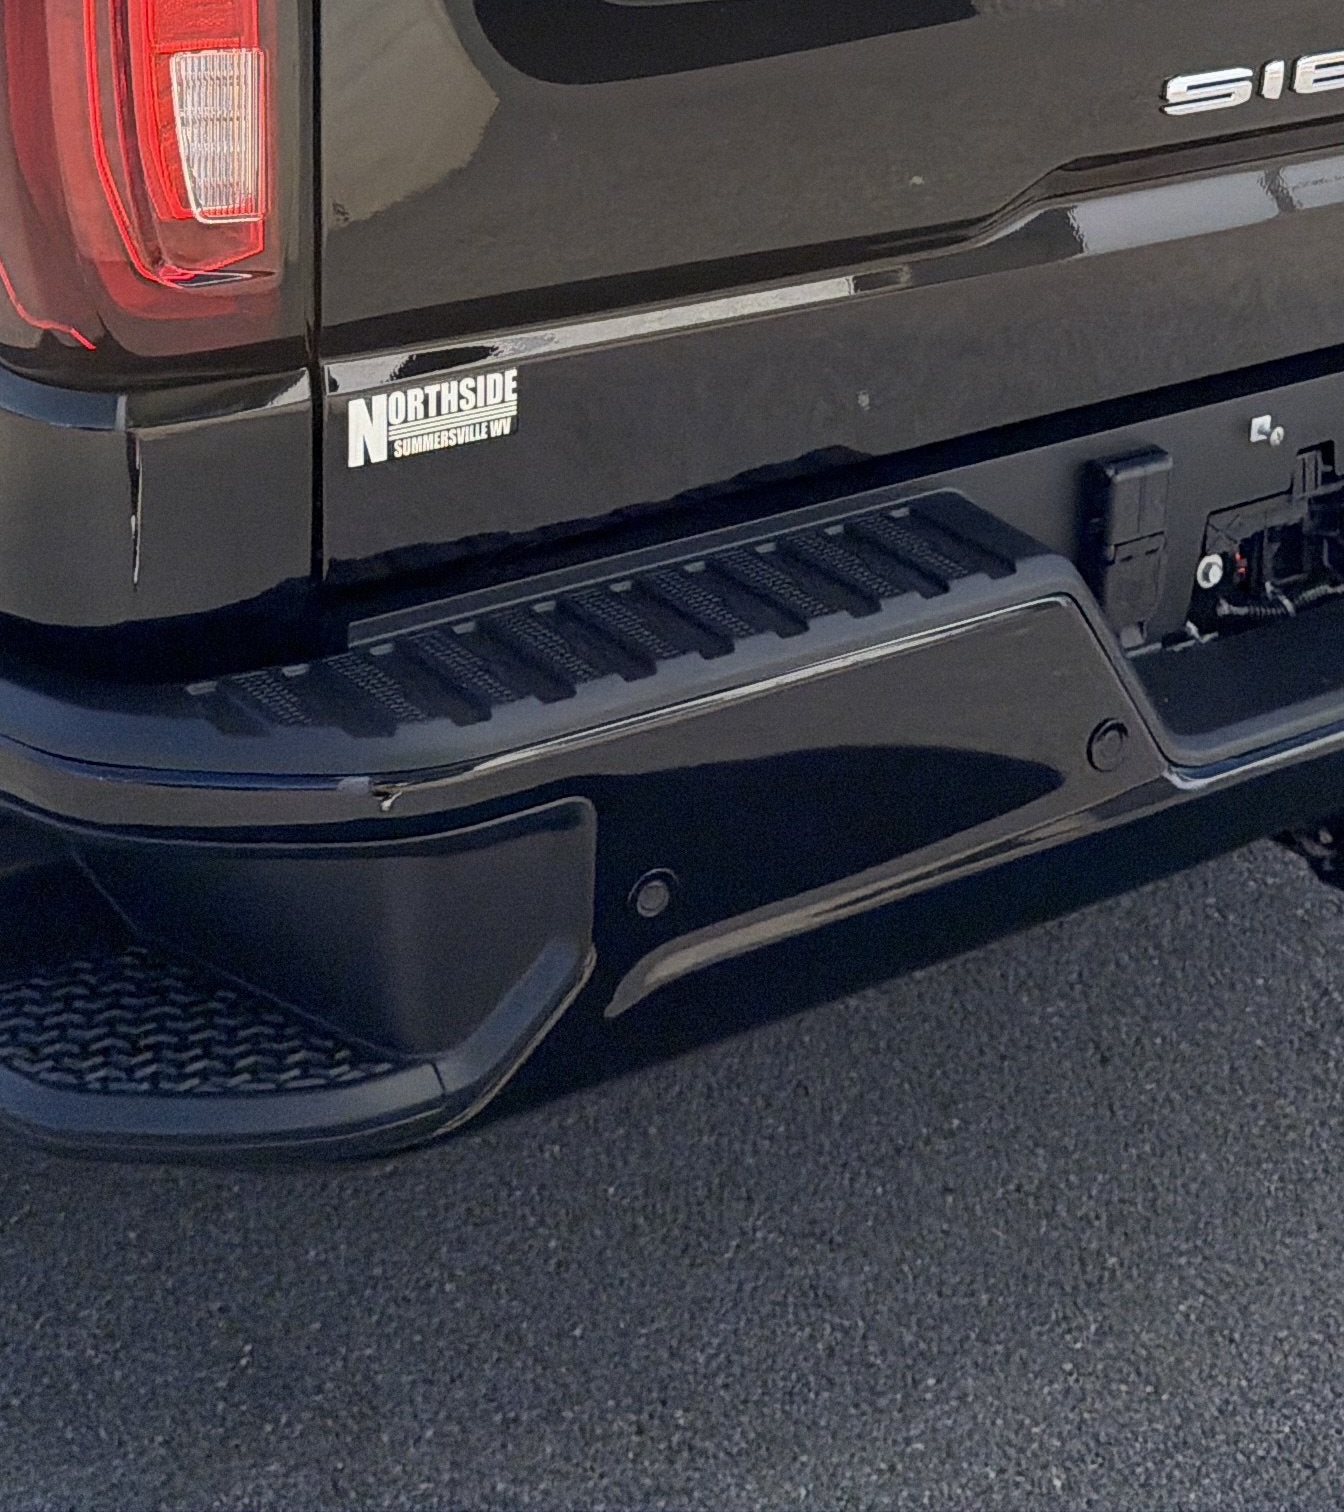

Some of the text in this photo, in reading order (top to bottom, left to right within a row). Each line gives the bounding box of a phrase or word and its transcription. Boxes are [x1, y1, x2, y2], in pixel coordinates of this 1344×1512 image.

[347, 368, 518, 468] NORTHSIDE
[393, 417, 512, 459] SUMMERSVILLE WV
